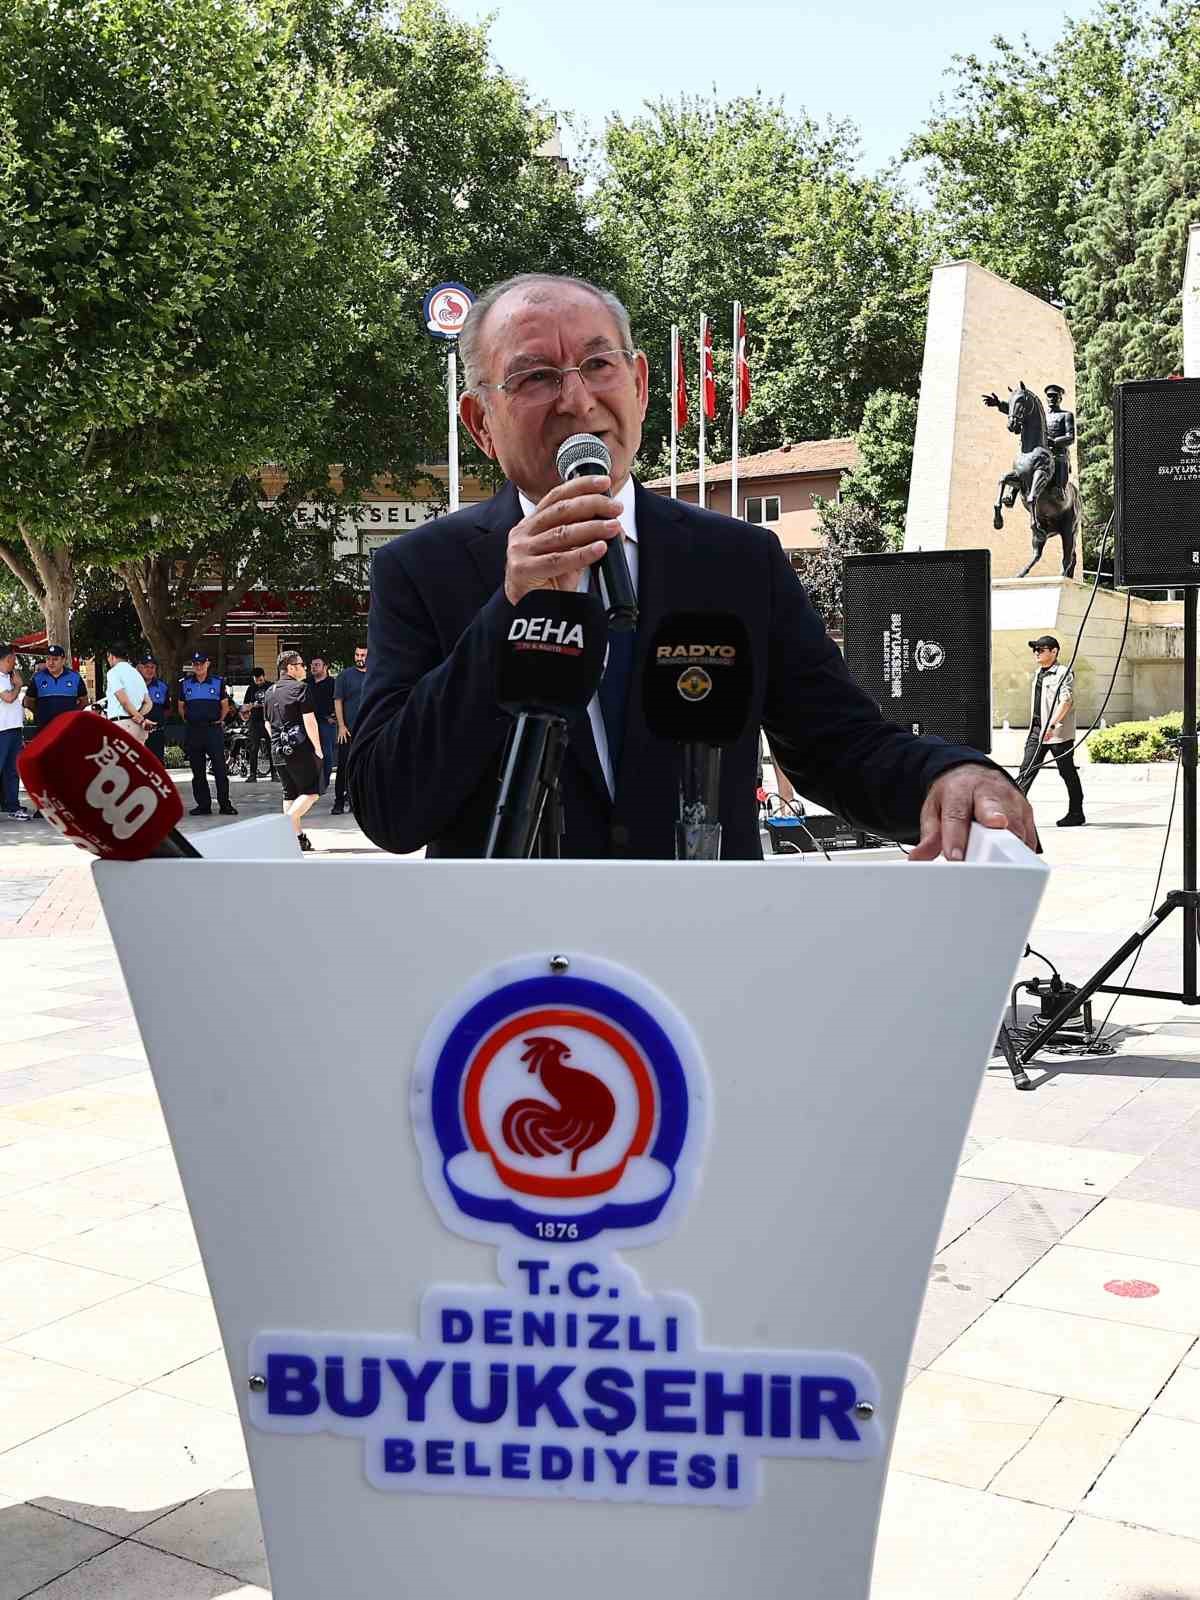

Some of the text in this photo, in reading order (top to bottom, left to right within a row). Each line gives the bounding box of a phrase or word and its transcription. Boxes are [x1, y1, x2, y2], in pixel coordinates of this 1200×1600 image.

[507, 617, 584, 649] DEHA
[656, 644, 737, 657] RADYO
[535, 1222, 579, 1239] 1876
[518, 1260, 619, 1298] T.C.
[266, 1354, 861, 1441] BÜYÜKŞEHİR
